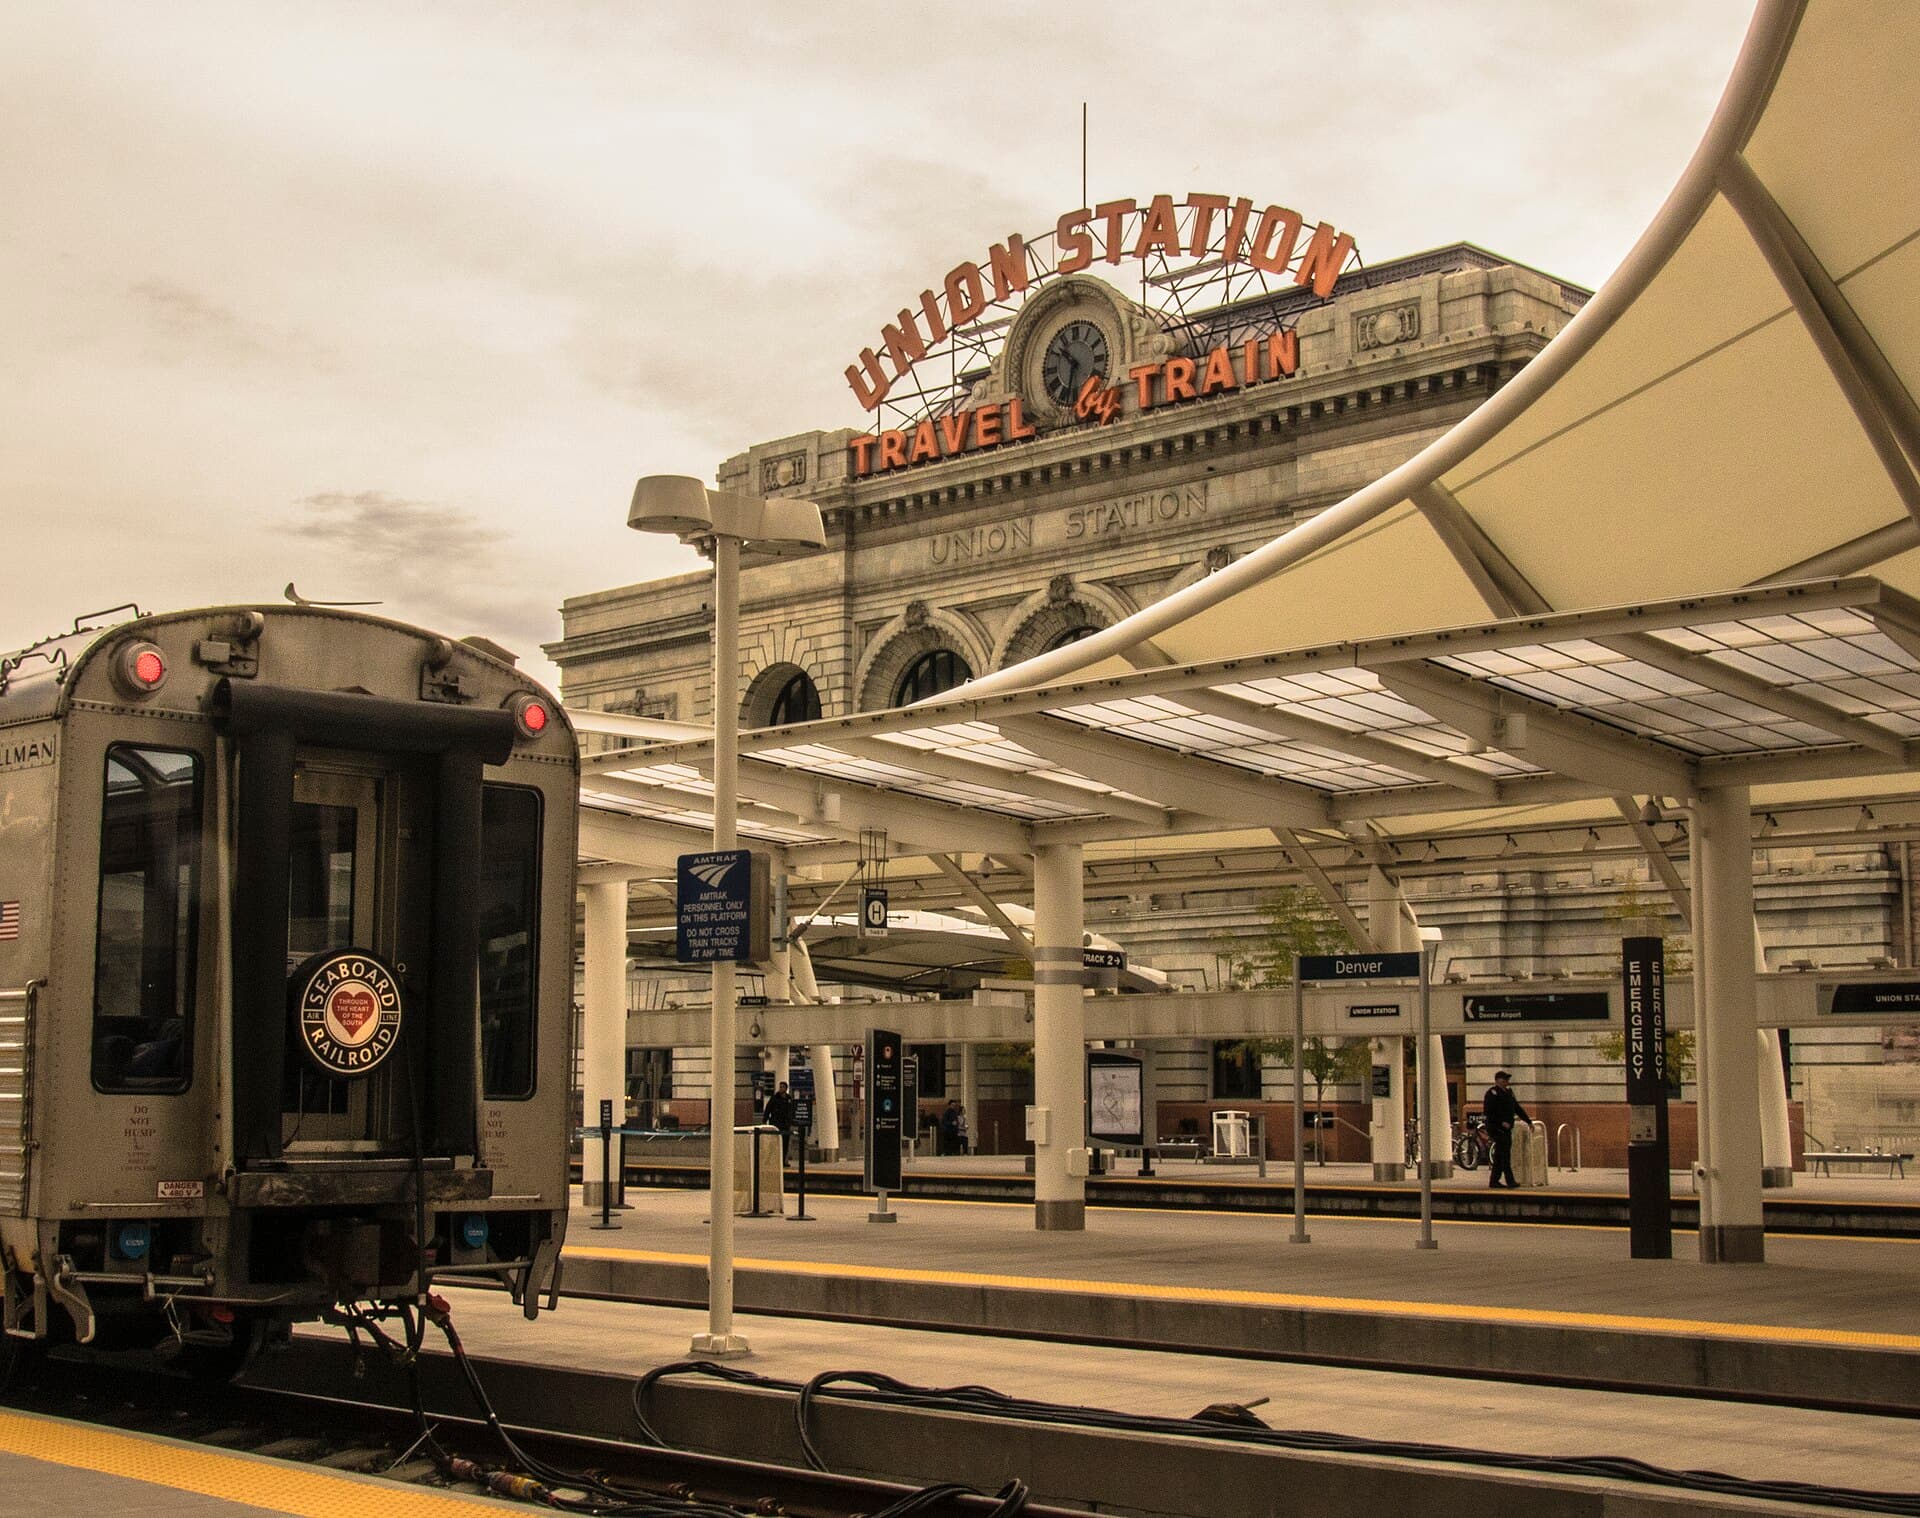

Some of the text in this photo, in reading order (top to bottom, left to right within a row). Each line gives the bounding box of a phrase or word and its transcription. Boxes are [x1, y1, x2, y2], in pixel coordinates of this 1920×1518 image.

[844, 193, 1354, 411] UNION STATION
[850, 329, 1299, 476] TRAVEL by TRAIN
[930, 483, 1208, 564] UNION STATION
[0, 741, 53, 766] LMAN
[693, 855, 737, 864] AMTRAK
[699, 891, 727, 900] AMTRAK
[683, 901, 744, 912] PERSONNEL ONLY
[872, 904, 881, 920] H
[680, 911, 747, 923] ON THIS PLATFORM
[686, 926, 740, 937] DO NOT CROSS
[688, 937, 738, 948] TRAIN TRACKS
[692, 948, 735, 958] AT ANY TIME
[1083, 953, 1114, 965] TRACK 2
[1335, 960, 1383, 974] Denver
[310, 962, 395, 1007] SEABOARD
[306, 1011, 398, 1021] AIR LINE
[1629, 961, 1643, 1080] EMERGENCY
[1652, 961, 1663, 1080] EMERGENCY
[311, 1028, 391, 1066] RAILROAD
[164, 1182, 197, 1190] DANGER
